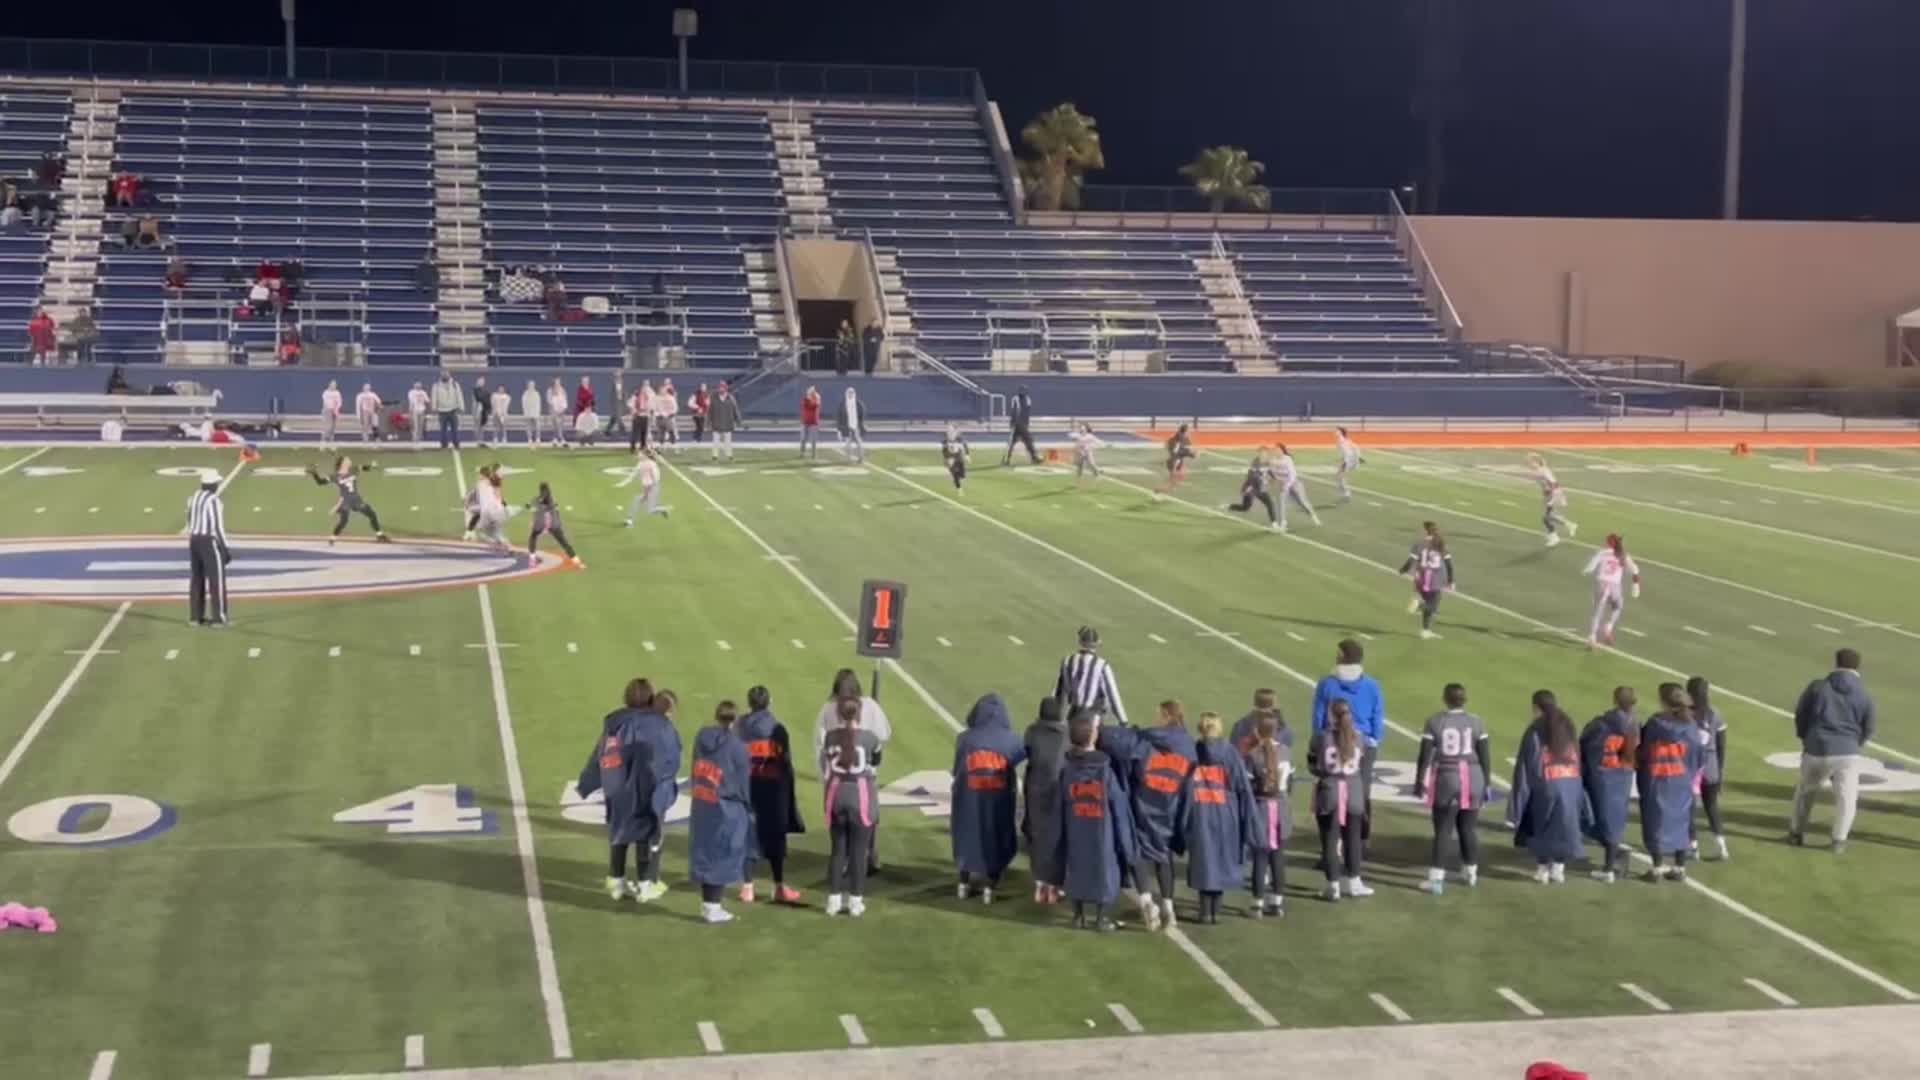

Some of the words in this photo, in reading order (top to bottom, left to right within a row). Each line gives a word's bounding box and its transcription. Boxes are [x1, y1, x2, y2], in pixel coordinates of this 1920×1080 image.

[873, 590, 892, 629] 1
[1442, 728, 1472, 756] 81
[7, 794, 170, 844] 0
[333, 784, 483, 833] 4
